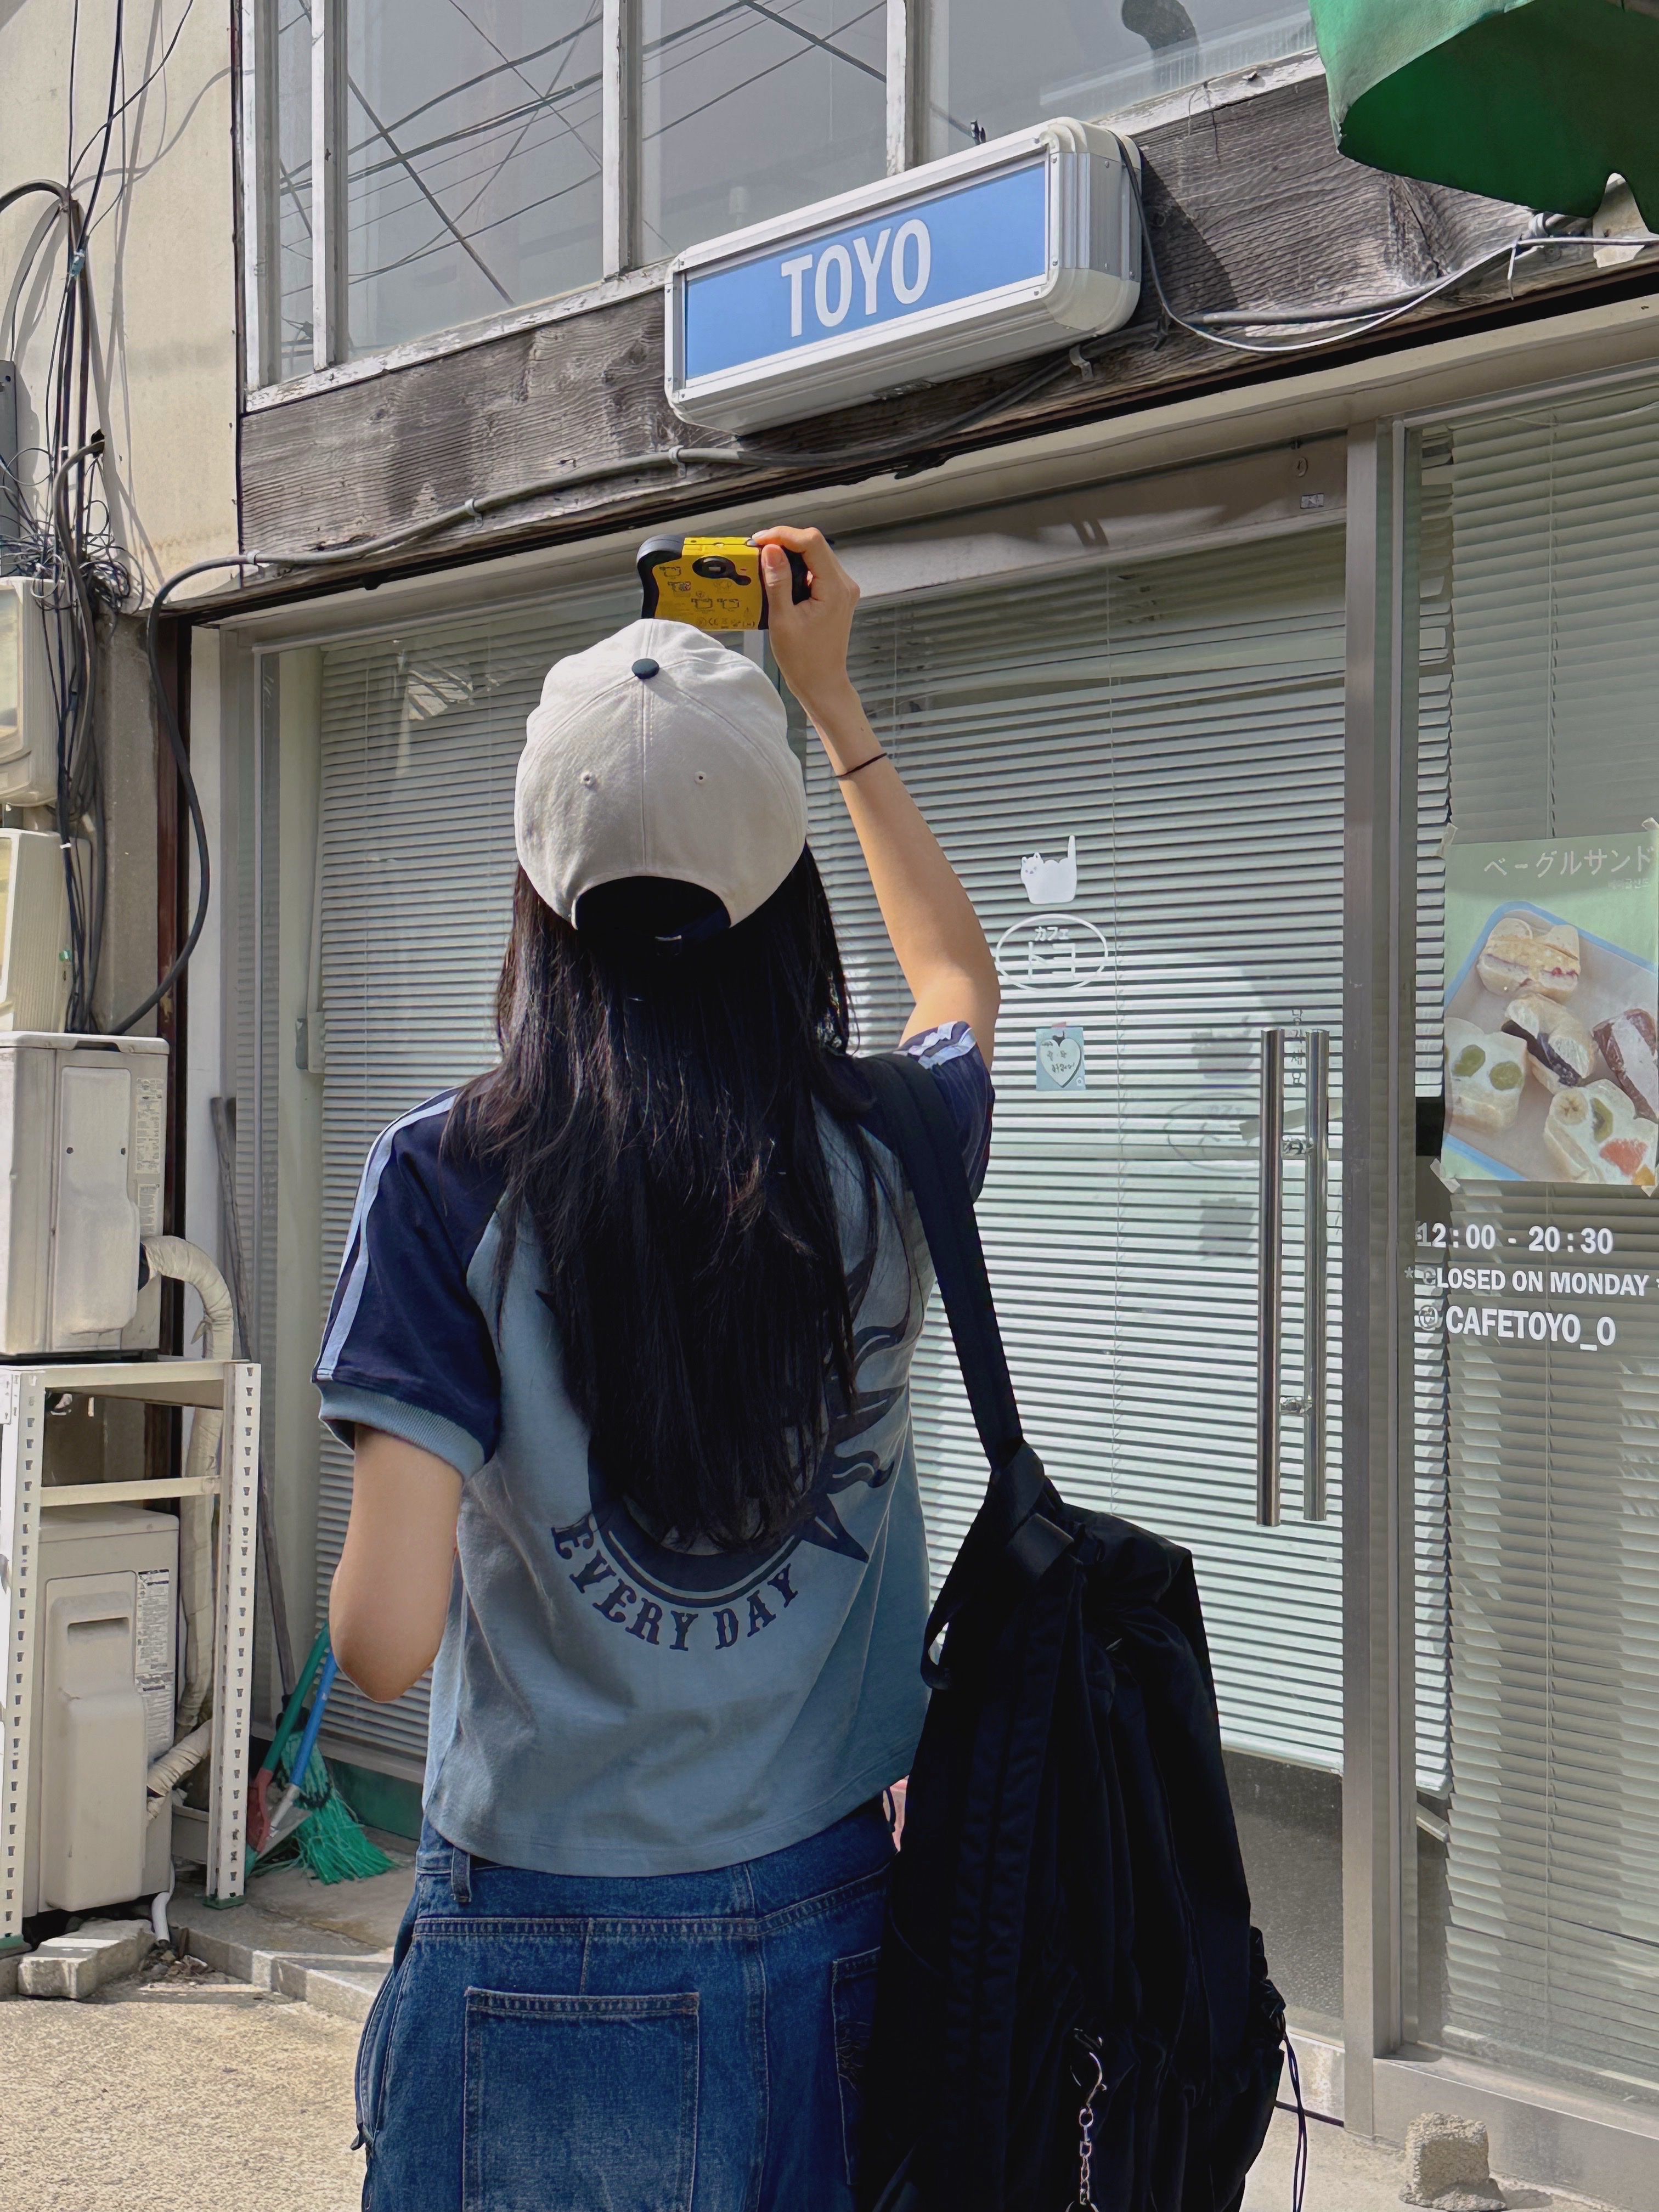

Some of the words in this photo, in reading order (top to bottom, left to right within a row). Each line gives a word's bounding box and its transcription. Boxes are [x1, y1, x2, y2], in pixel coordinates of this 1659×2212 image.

[781, 219, 931, 337] TOYO
[1485, 845, 1655, 878] ベーグルサンド
[1035, 927, 1069, 940] カフェ
[1028, 941, 1076, 980] トヨ
[1417, 1223, 1496, 1250] 12:00
[1528, 1225, 1614, 1255] 20:30
[1513, 1270, 1544, 1292] ON
[1550, 1272, 1649, 1296] MONDAY
